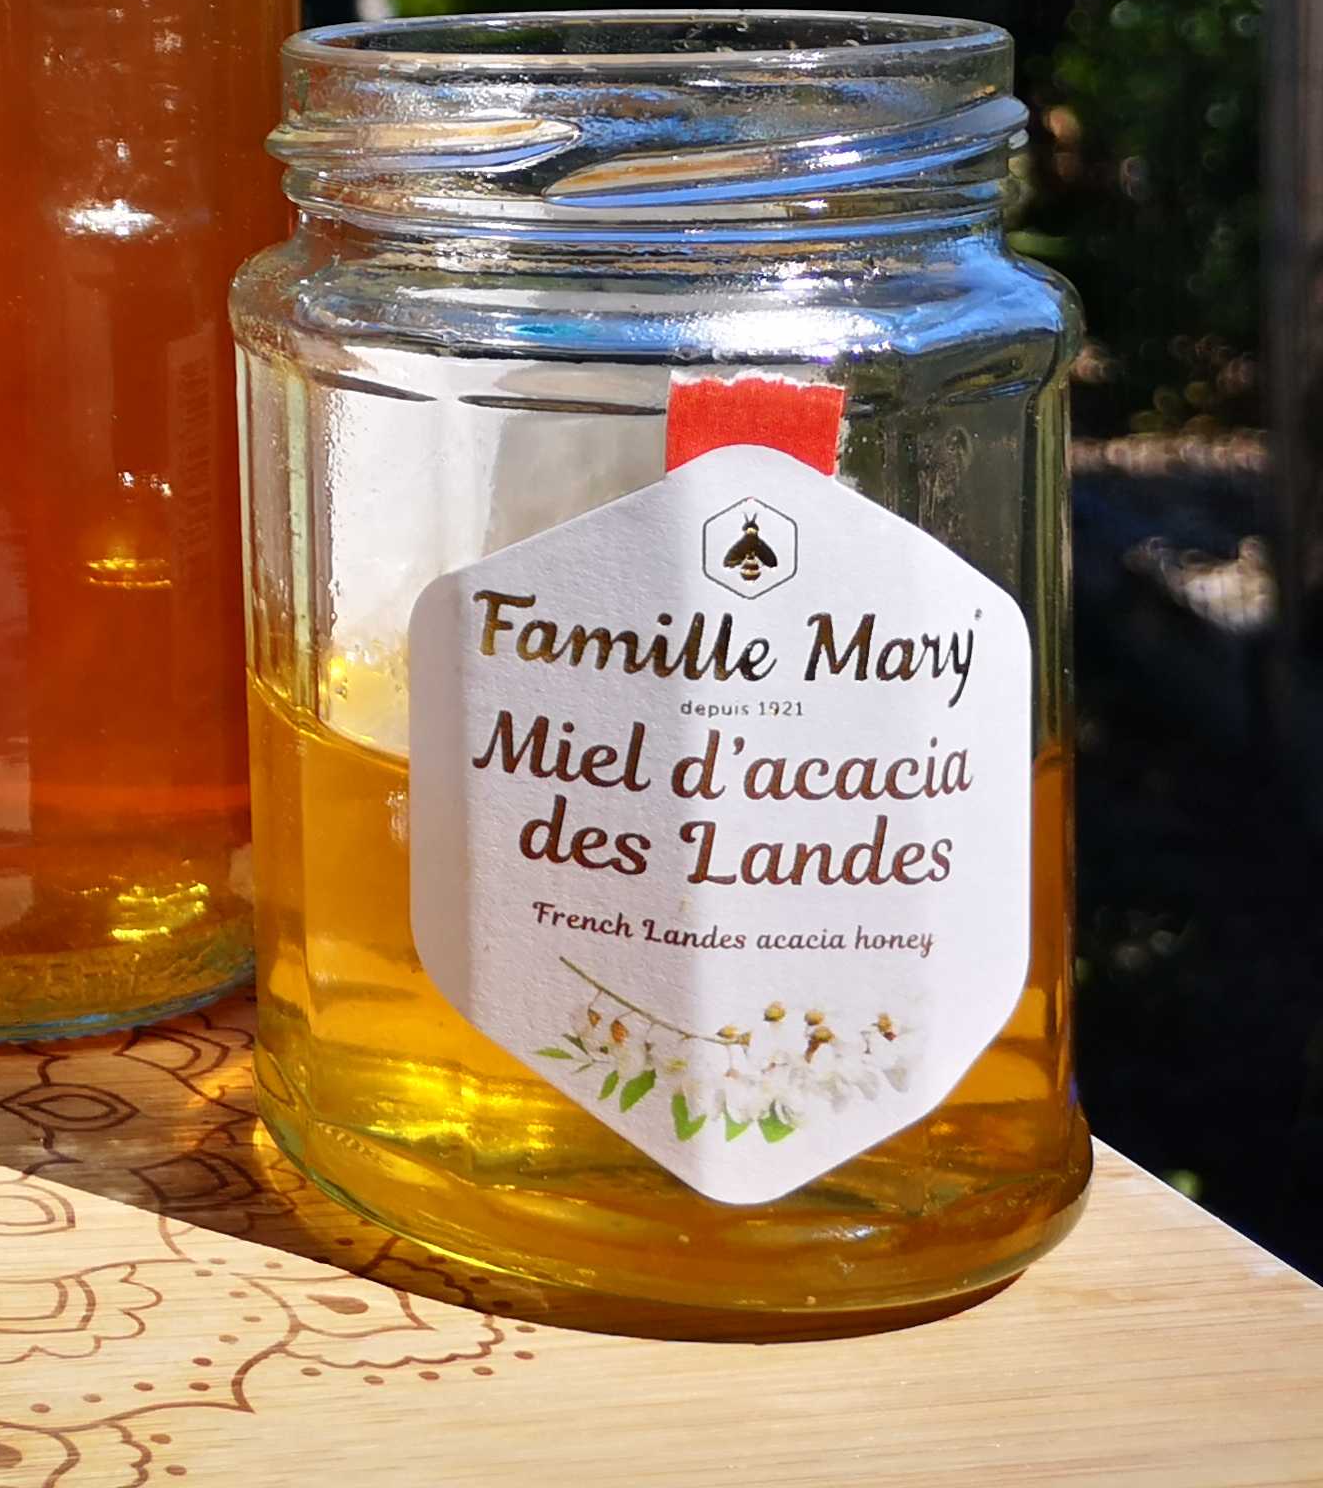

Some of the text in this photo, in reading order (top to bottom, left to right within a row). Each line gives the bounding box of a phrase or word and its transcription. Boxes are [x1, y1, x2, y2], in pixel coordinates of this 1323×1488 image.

[472, 590, 777, 681] Famille
[680, 700, 804, 718] depuis 1921
[471, 710, 974, 801] Miel d'acacia
[519, 796, 953, 885] des Landes
[532, 901, 934, 958] French Landes acacia honey
